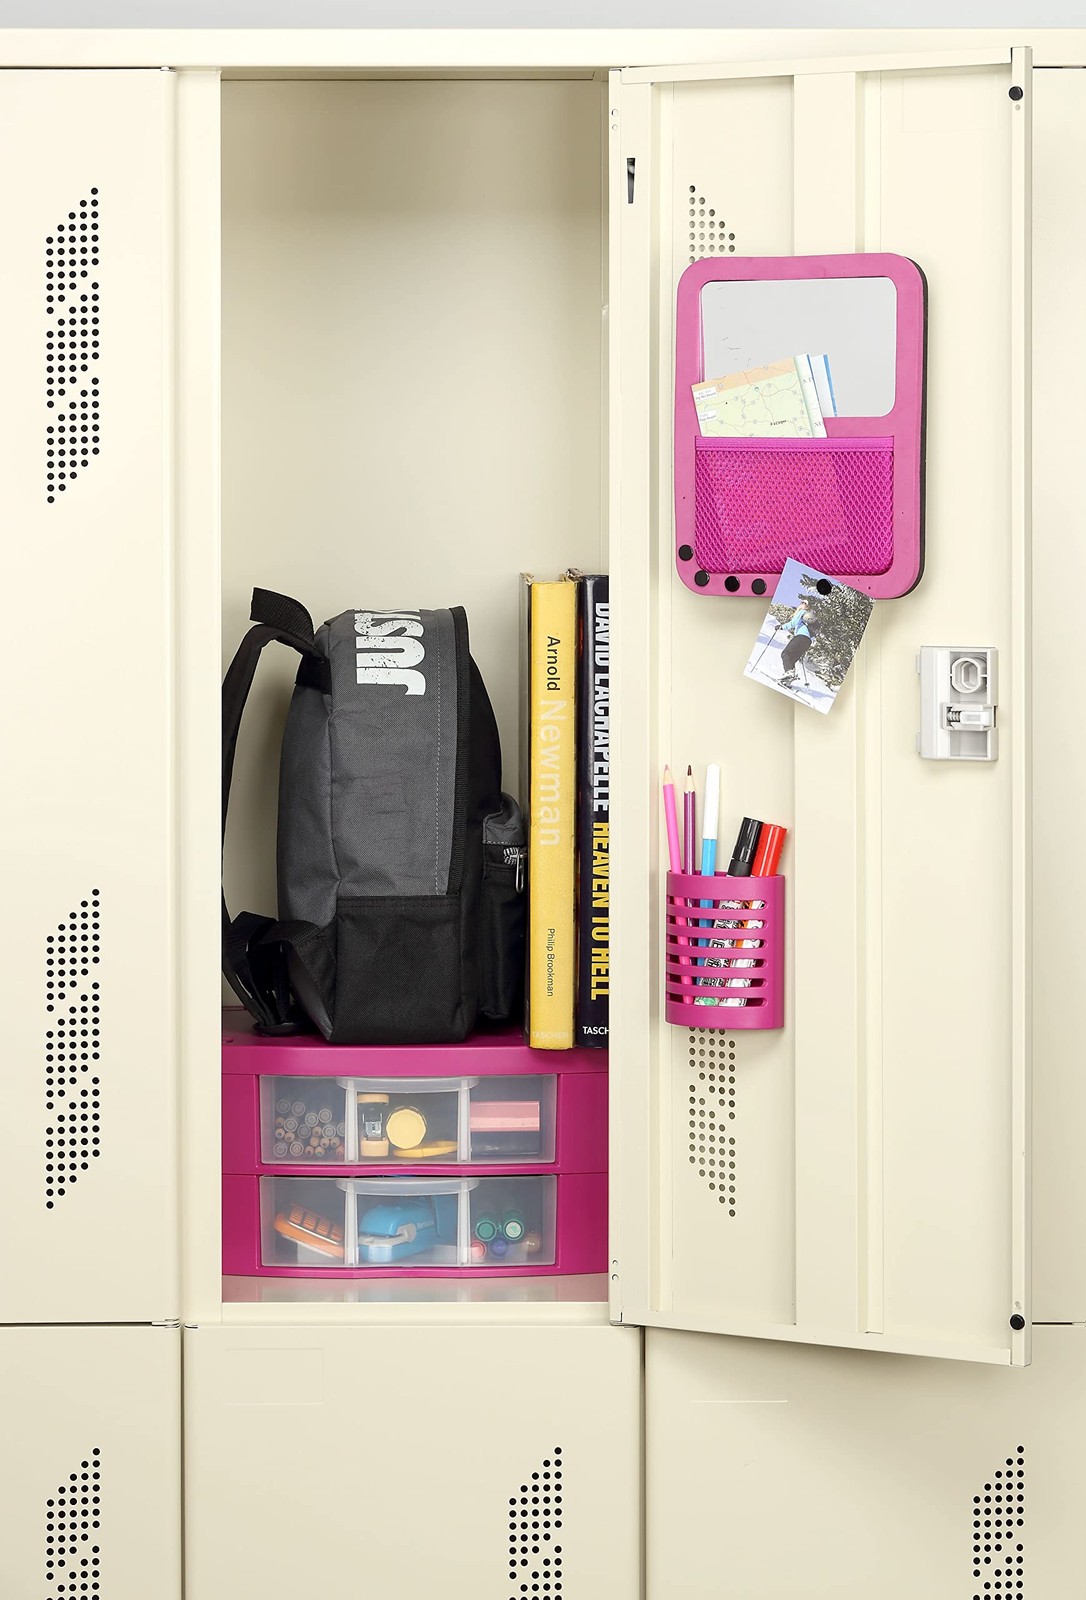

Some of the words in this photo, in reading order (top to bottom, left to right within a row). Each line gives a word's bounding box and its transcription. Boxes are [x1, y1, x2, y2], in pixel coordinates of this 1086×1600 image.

[547, 636, 561, 690] Arnold
[540, 700, 566, 845] Newman
[546, 928, 555, 951] Philip
[546, 953, 555, 996] Brookman
